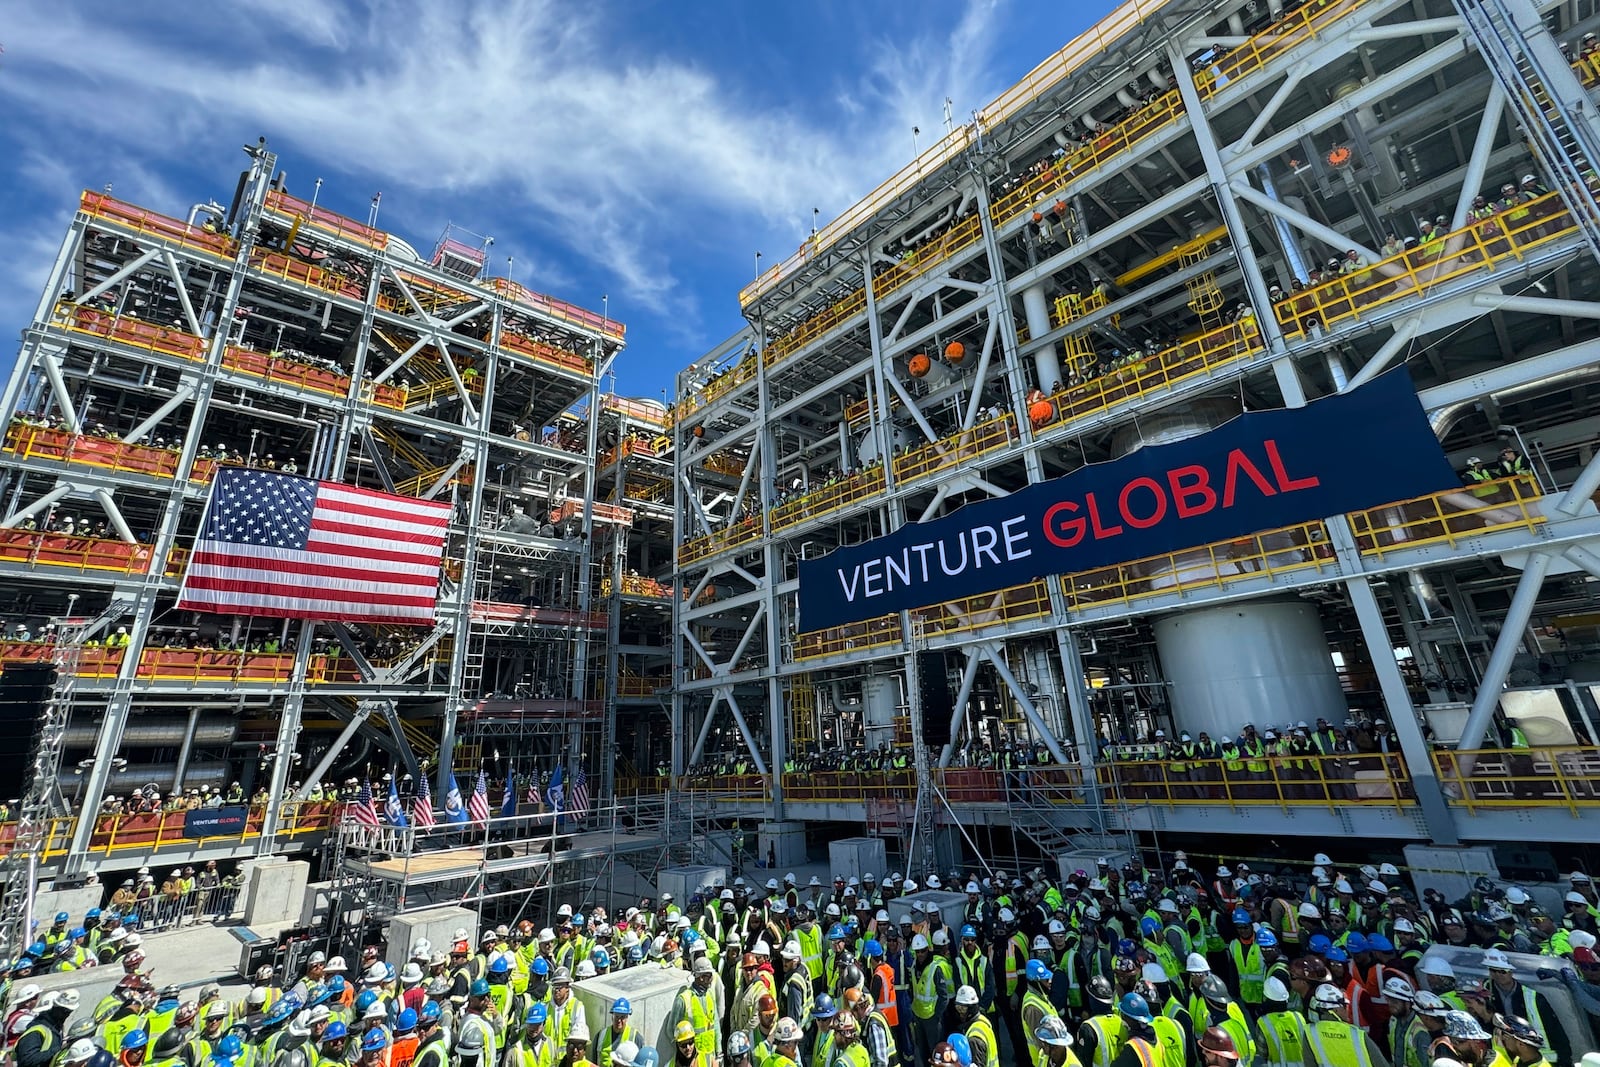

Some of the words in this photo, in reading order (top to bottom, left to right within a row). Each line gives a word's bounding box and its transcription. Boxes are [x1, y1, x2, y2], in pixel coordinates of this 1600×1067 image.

[838, 515, 1031, 602] VENTURE
[1042, 439, 1320, 547] GLOBAL
[1321, 1031, 1347, 1039] TELECOM
